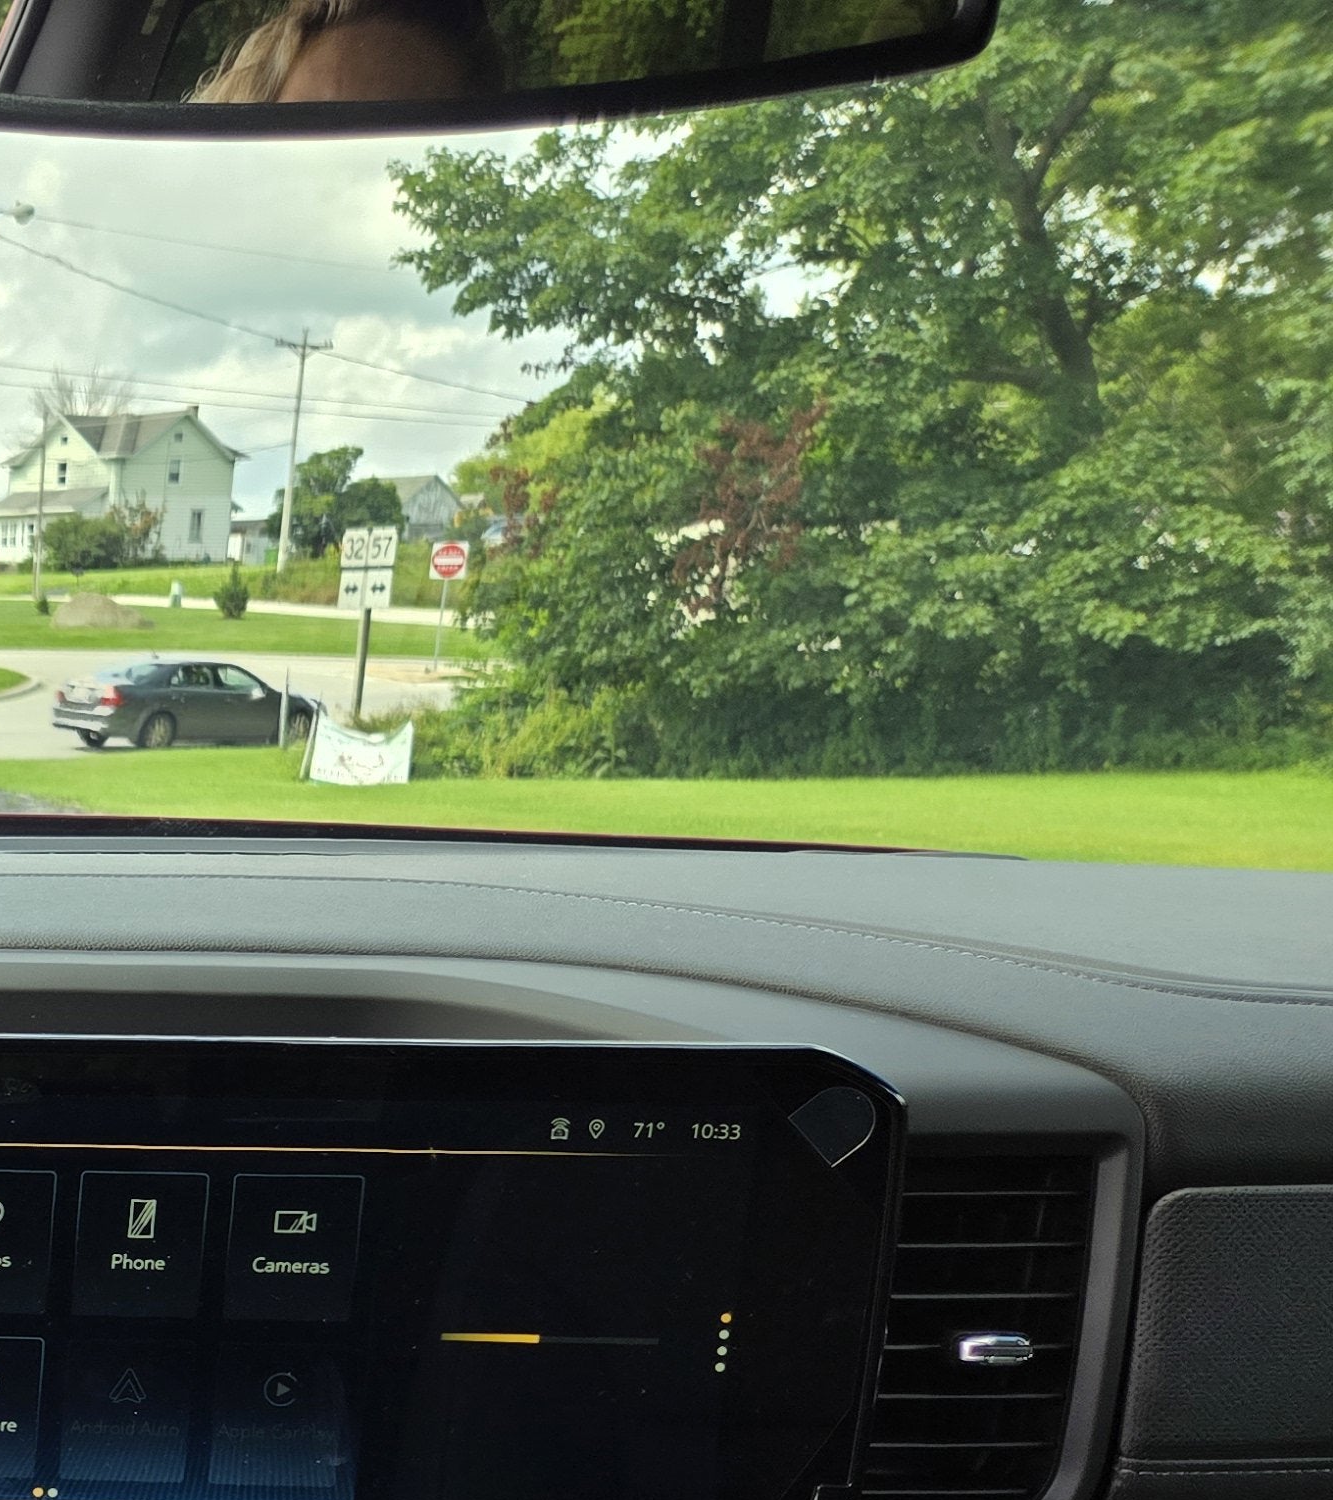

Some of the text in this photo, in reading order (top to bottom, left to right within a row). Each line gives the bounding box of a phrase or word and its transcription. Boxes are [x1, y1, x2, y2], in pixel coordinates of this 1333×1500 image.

[344, 537, 365, 560] 32
[372, 536, 393, 559] 57
[634, 1122, 665, 1138] 71°
[692, 1124, 740, 1139] 10:33
[112, 1254, 165, 1270] Phone
[253, 1257, 329, 1274] Cameras
